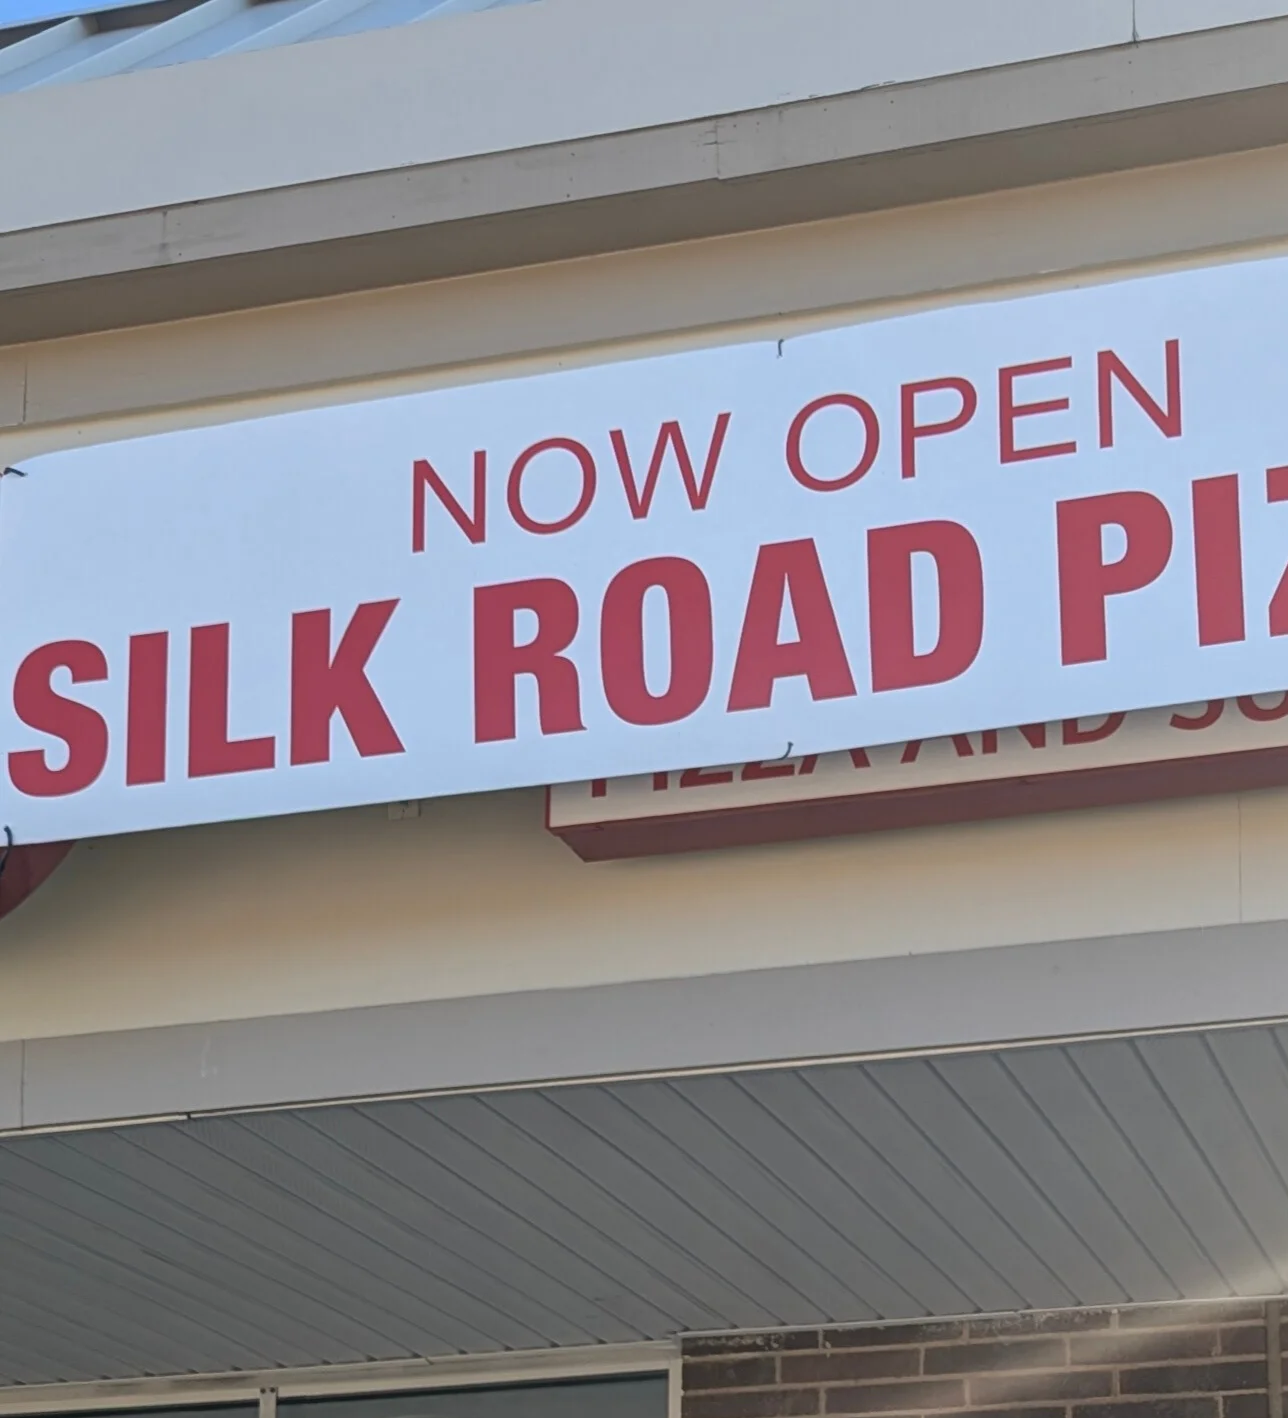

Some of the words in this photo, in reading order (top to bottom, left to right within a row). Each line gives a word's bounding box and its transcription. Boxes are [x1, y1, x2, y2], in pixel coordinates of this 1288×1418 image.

[412, 413, 731, 552] NOW
[786, 340, 1182, 492] OPEN
[7, 598, 406, 797] SILK
[474, 518, 984, 743] ROAD
